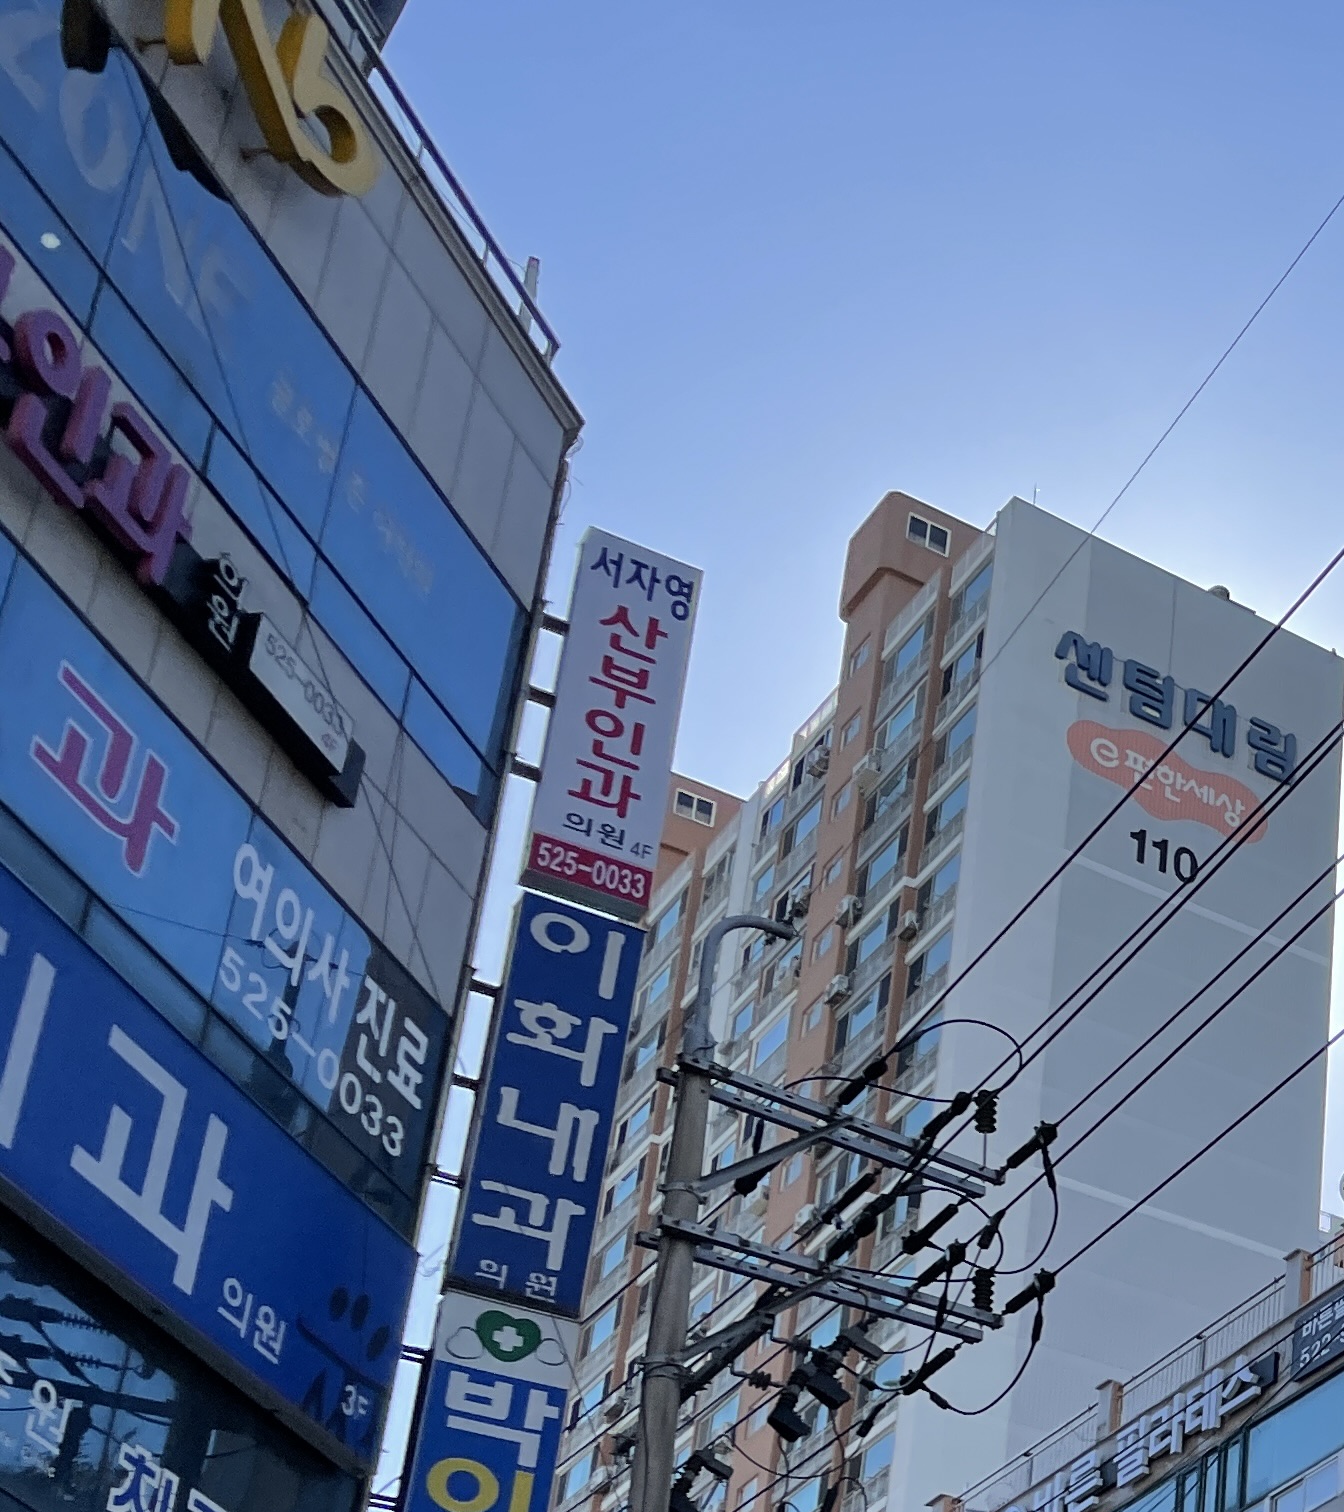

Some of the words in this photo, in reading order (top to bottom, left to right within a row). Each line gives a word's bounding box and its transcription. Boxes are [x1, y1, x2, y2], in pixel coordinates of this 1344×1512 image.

[590, 547, 696, 622] 서자영
[566, 604, 669, 819] 산부인과
[1055, 630, 1298, 786] 센텀대림
[536, 841, 646, 899] 525-0033
[562, 811, 626, 850] 의원
[1129, 828, 1200, 885] 110
[218, 945, 405, 1157] 525-0033
[356, 974, 430, 1111] 진료
[471, 911, 628, 1272] 이화내과
[217, 1276, 289, 1365] 의원
[474, 1259, 558, 1304] 의원
[1113, 1354, 1264, 1487] 필라테스
